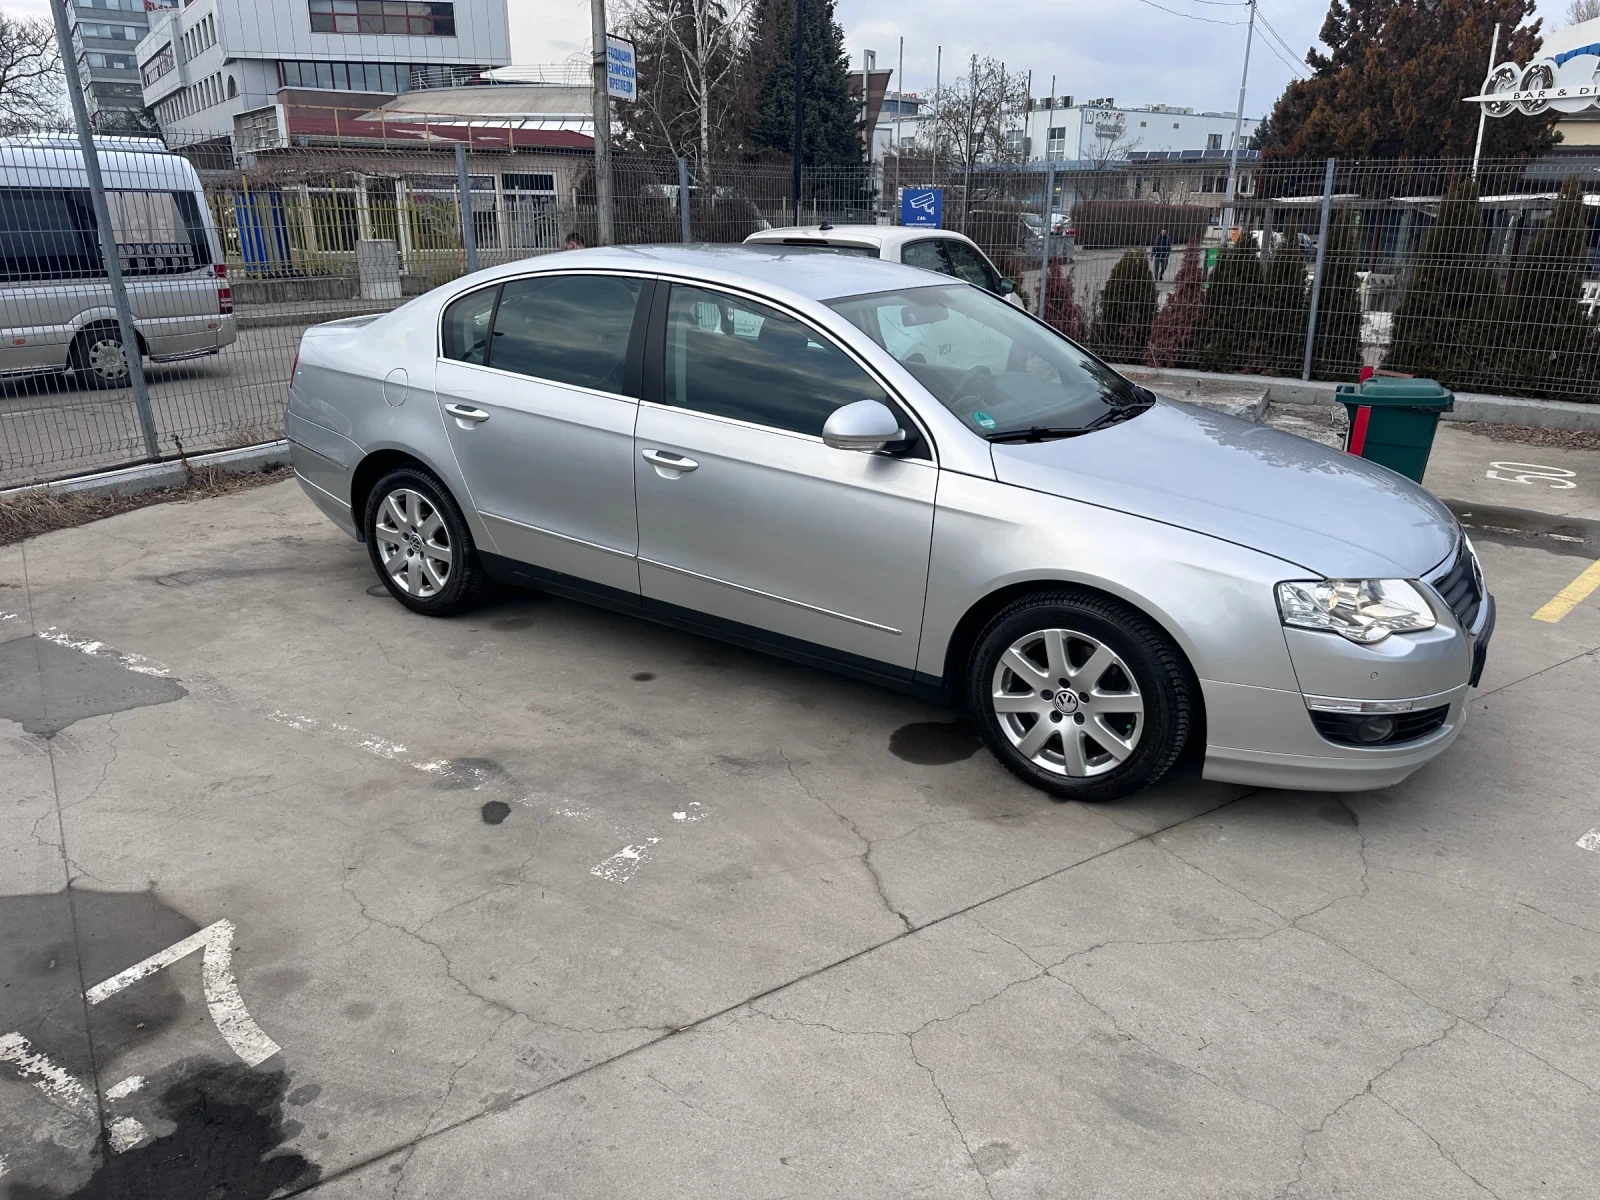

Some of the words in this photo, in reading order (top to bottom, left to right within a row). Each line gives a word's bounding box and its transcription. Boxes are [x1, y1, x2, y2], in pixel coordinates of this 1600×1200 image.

[608, 62, 635, 78] ЕХНИЧЕСКИ
[1513, 90, 1546, 99] BAR
[1557, 88, 1567, 96] &
[147, 244, 194, 255] CENTER
[104, 256, 196, 271] UROPE
[1485, 461, 1577, 489] 50
